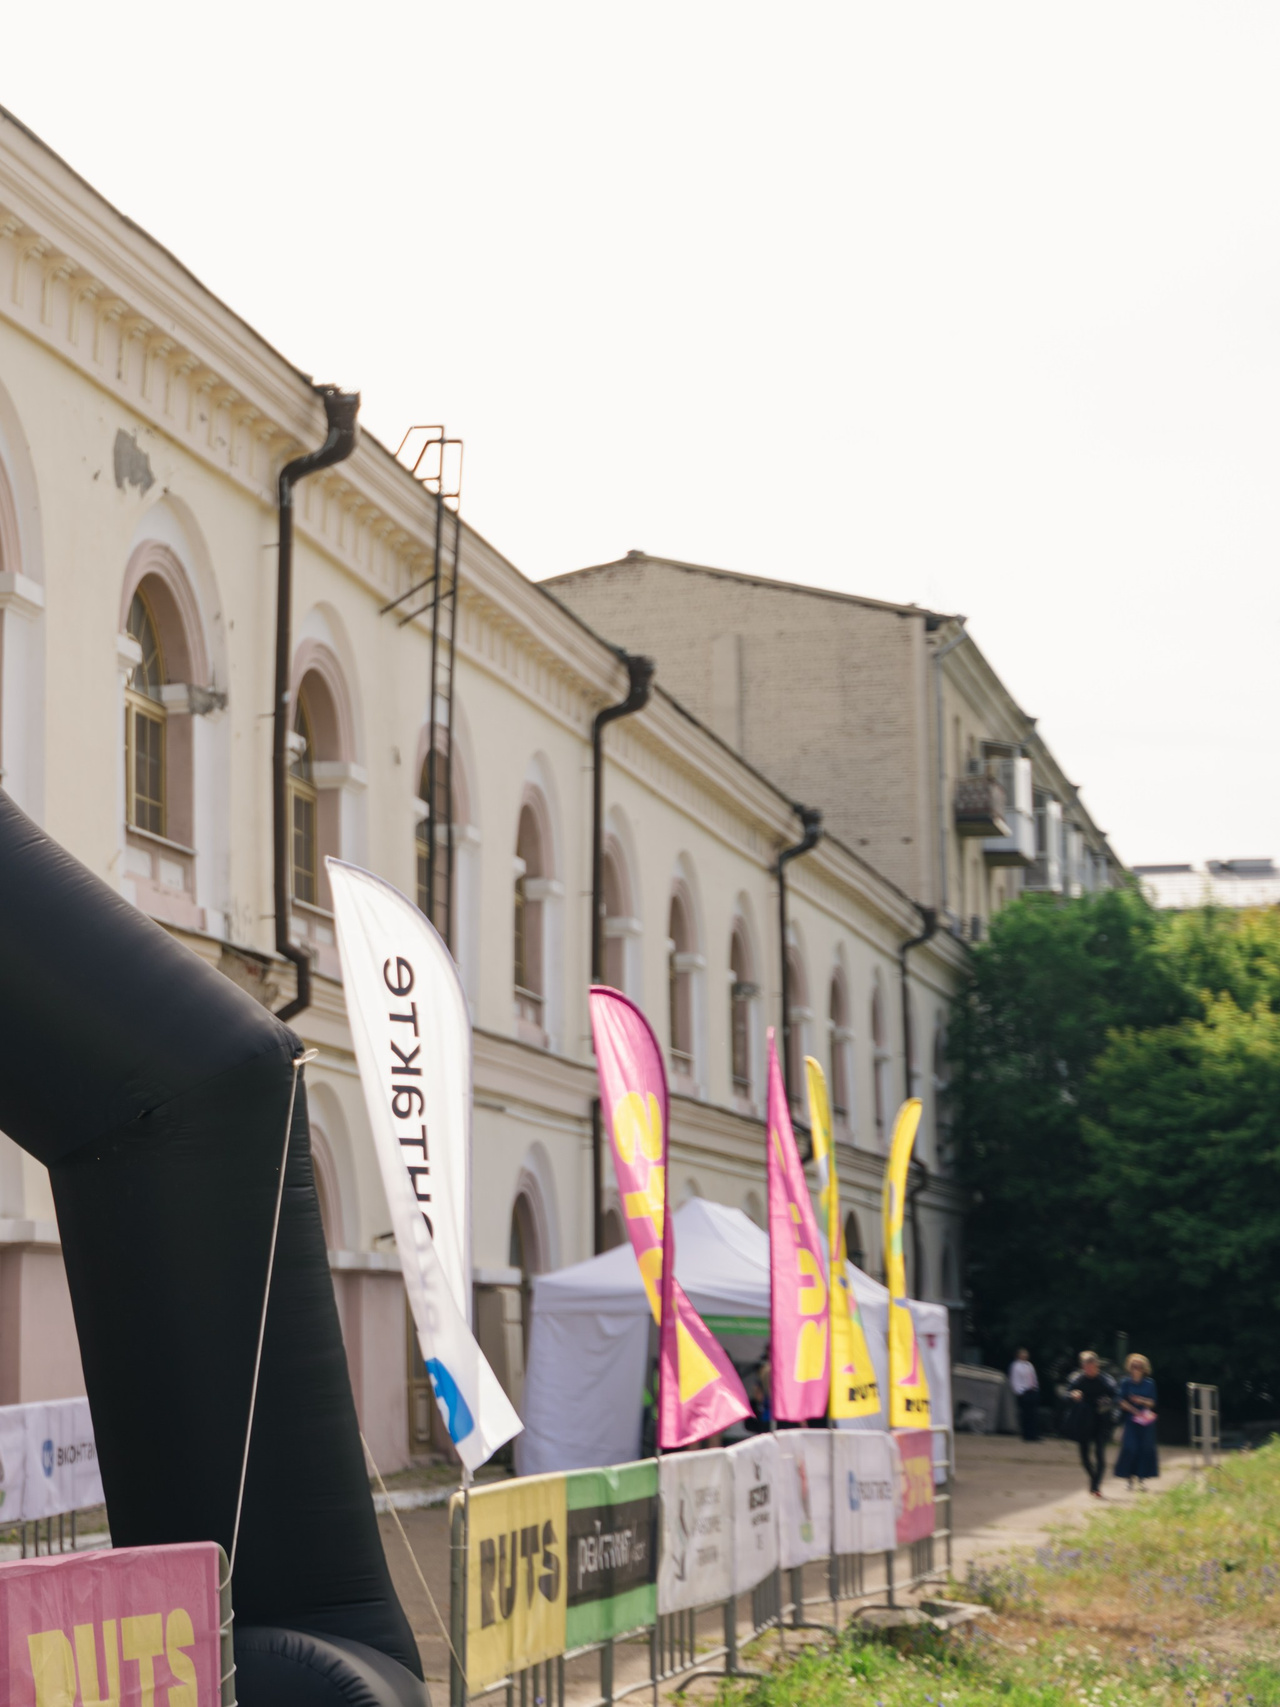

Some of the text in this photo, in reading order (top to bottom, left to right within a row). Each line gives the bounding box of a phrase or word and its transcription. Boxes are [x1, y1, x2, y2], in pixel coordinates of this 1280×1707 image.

[848, 1383, 879, 1401] RUT
[905, 1398, 930, 1412] RUT
[480, 1519, 561, 1631] RUTS
[28, 1608, 199, 1707] RUTS
